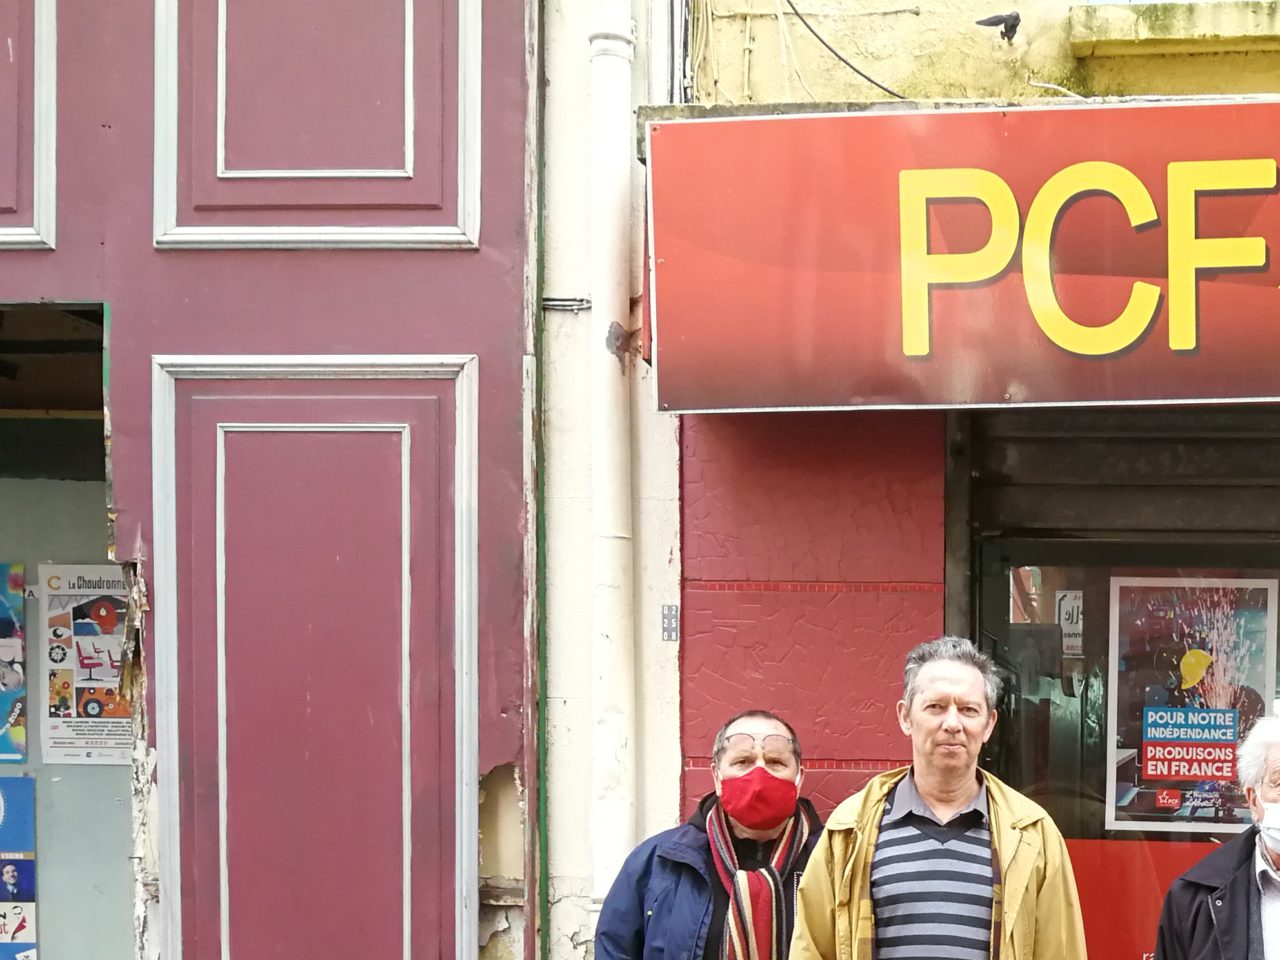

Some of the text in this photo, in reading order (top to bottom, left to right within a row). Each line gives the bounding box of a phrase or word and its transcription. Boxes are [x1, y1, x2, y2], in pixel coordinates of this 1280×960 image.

[899, 158, 1278, 356] PCF
[1147, 711, 1234, 725] POUR NOTRE
[1147, 725, 1234, 739] INDÉPENDANCE
[1147, 746, 1233, 760] PRODUISONS
[1147, 761, 1232, 776] EN FRANCE
